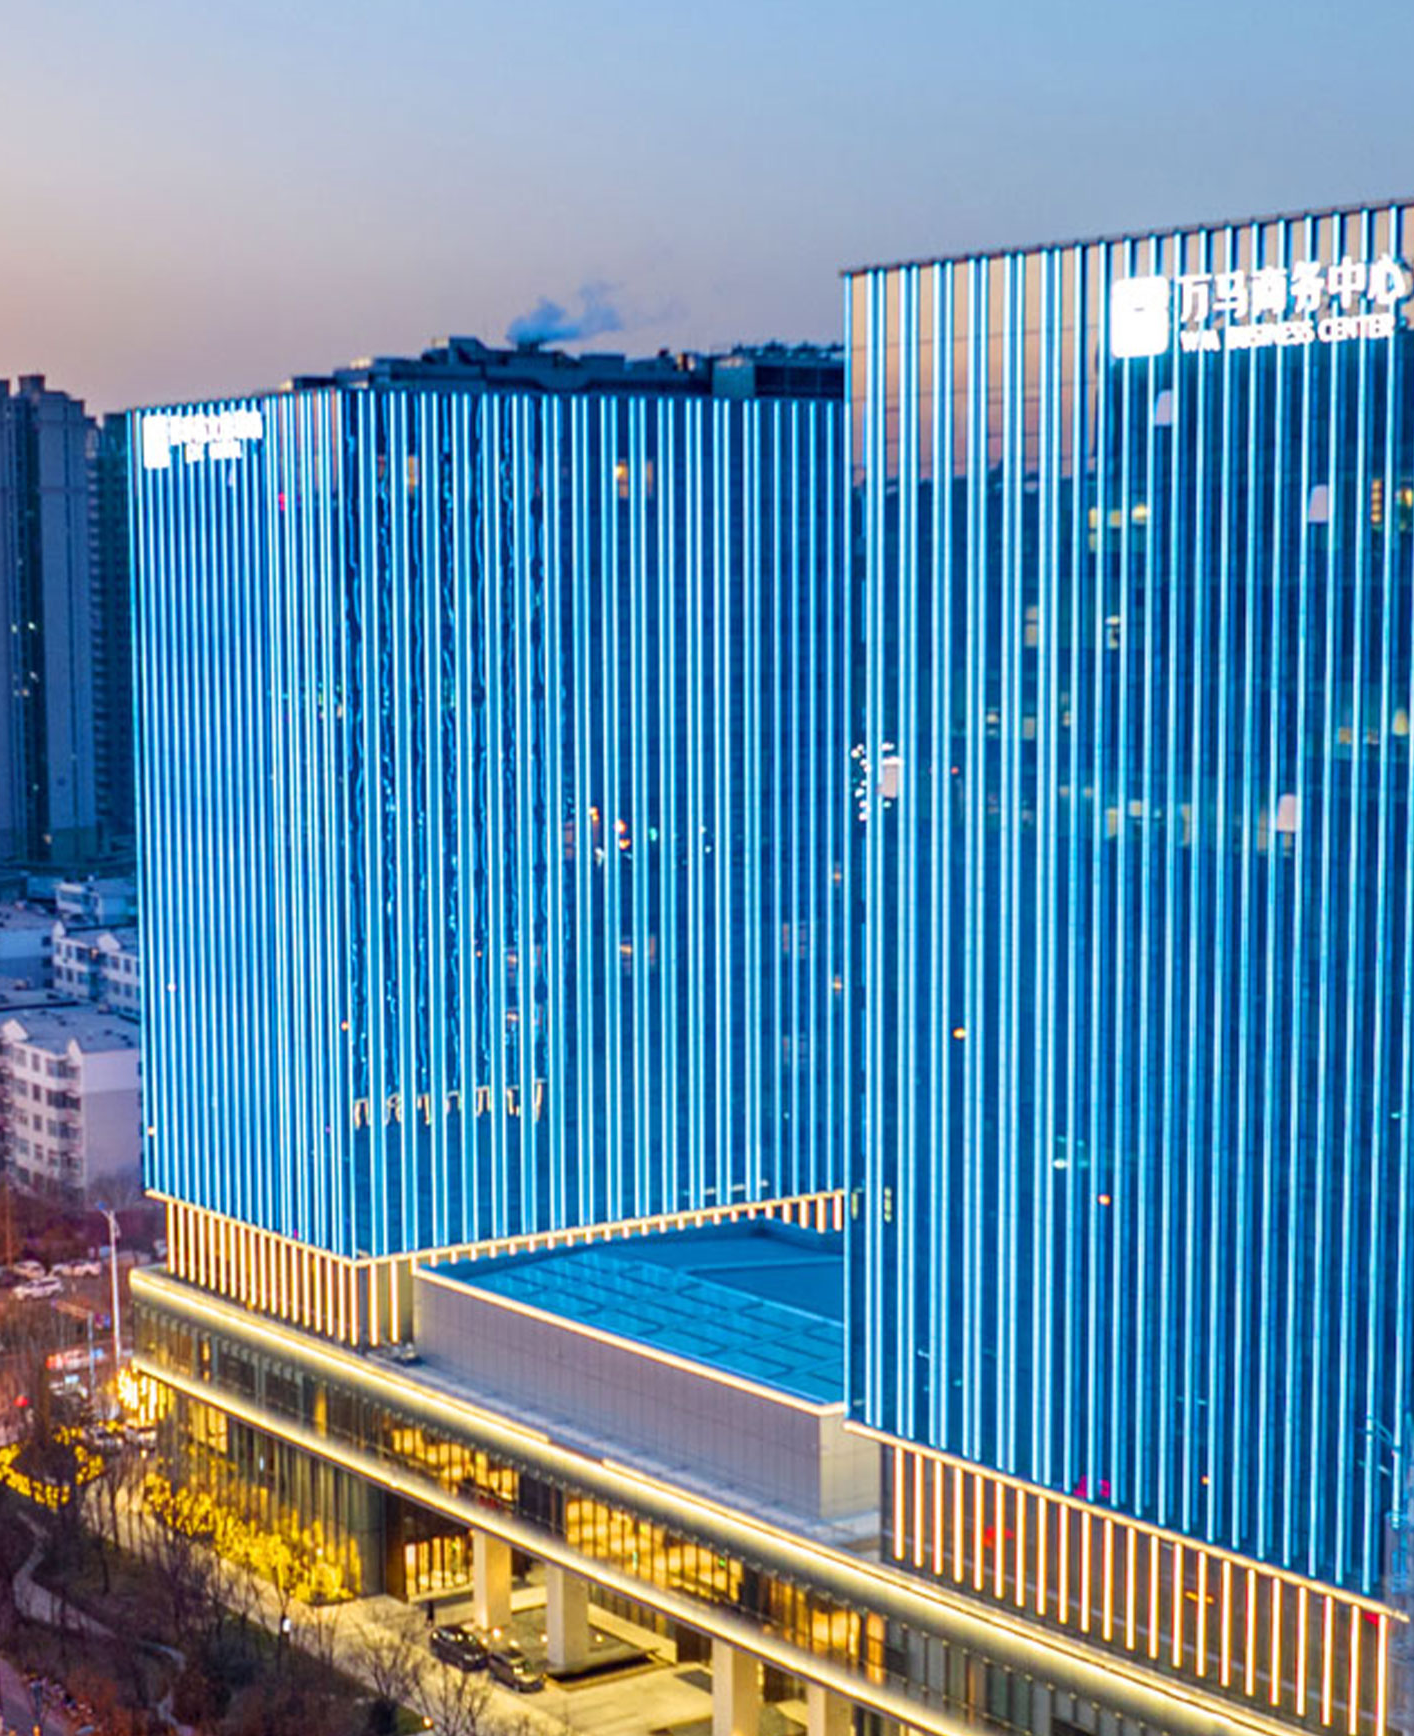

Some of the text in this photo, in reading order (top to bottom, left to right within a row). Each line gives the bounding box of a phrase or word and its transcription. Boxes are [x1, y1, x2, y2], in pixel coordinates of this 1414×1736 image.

[1177, 253, 1406, 323] 万马商务中心
[1318, 313, 1394, 342] CENTER
